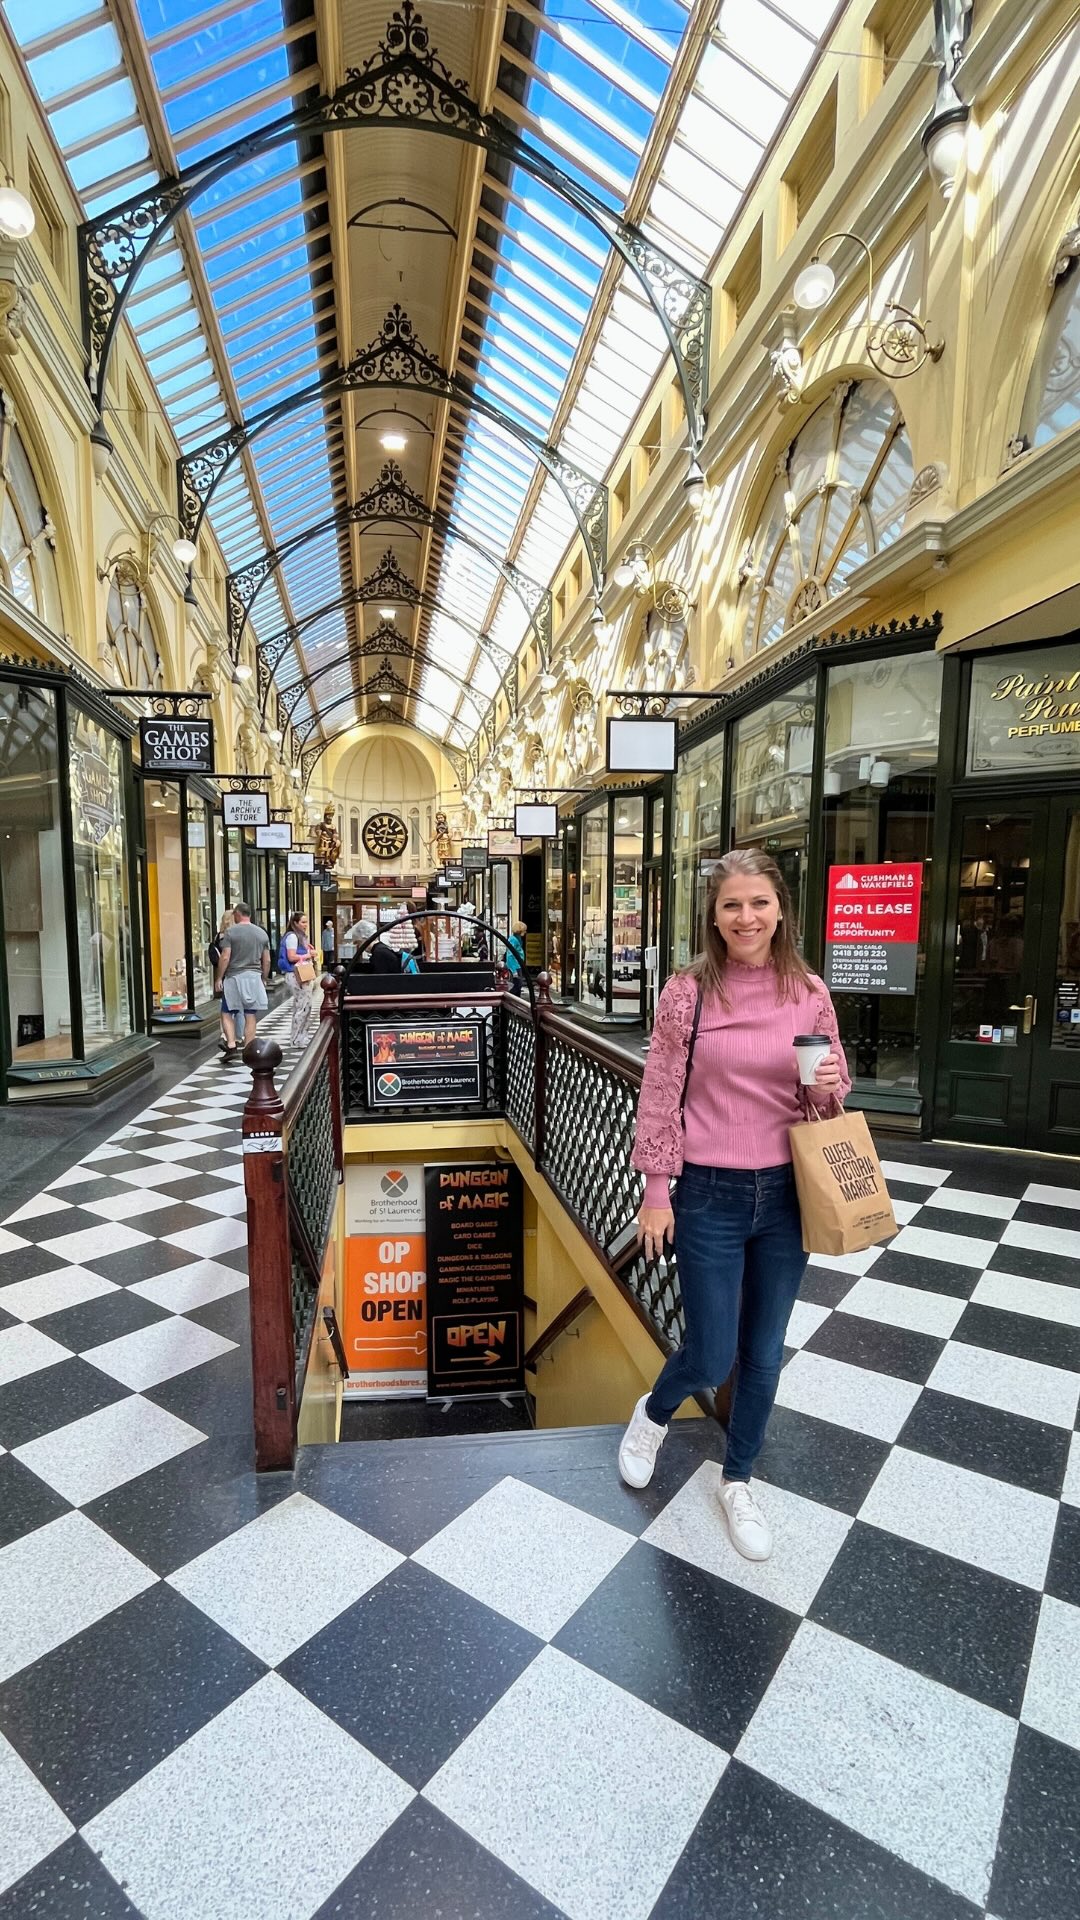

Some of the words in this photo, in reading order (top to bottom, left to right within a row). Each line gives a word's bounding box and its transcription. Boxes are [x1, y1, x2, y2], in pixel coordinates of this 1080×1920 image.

[144, 730, 209, 747] GAMES
[153, 745, 201, 760] SHOP
[834, 904, 863, 915] FOR
[867, 903, 913, 915] LEASE
[399, 1031, 436, 1044] DUNGEON
[437, 1031, 445, 1043] of
[446, 1029, 474, 1043] MAGIC
[401, 1077, 437, 1086] Brotherhood
[822, 1140, 858, 1165] QUEEN
[440, 1168, 509, 1188] DUNGEON
[830, 1155, 877, 1184] VICTORIA
[839, 1174, 879, 1204] MARKET
[371, 1199, 418, 1207] Brotherhood
[440, 1194, 455, 1210] of
[458, 1191, 509, 1209] MAGIC
[379, 1241, 410, 1264] OP
[364, 1270, 427, 1295] SHOP
[361, 1299, 423, 1322] OPEN
[447, 1320, 507, 1347] OPEN
